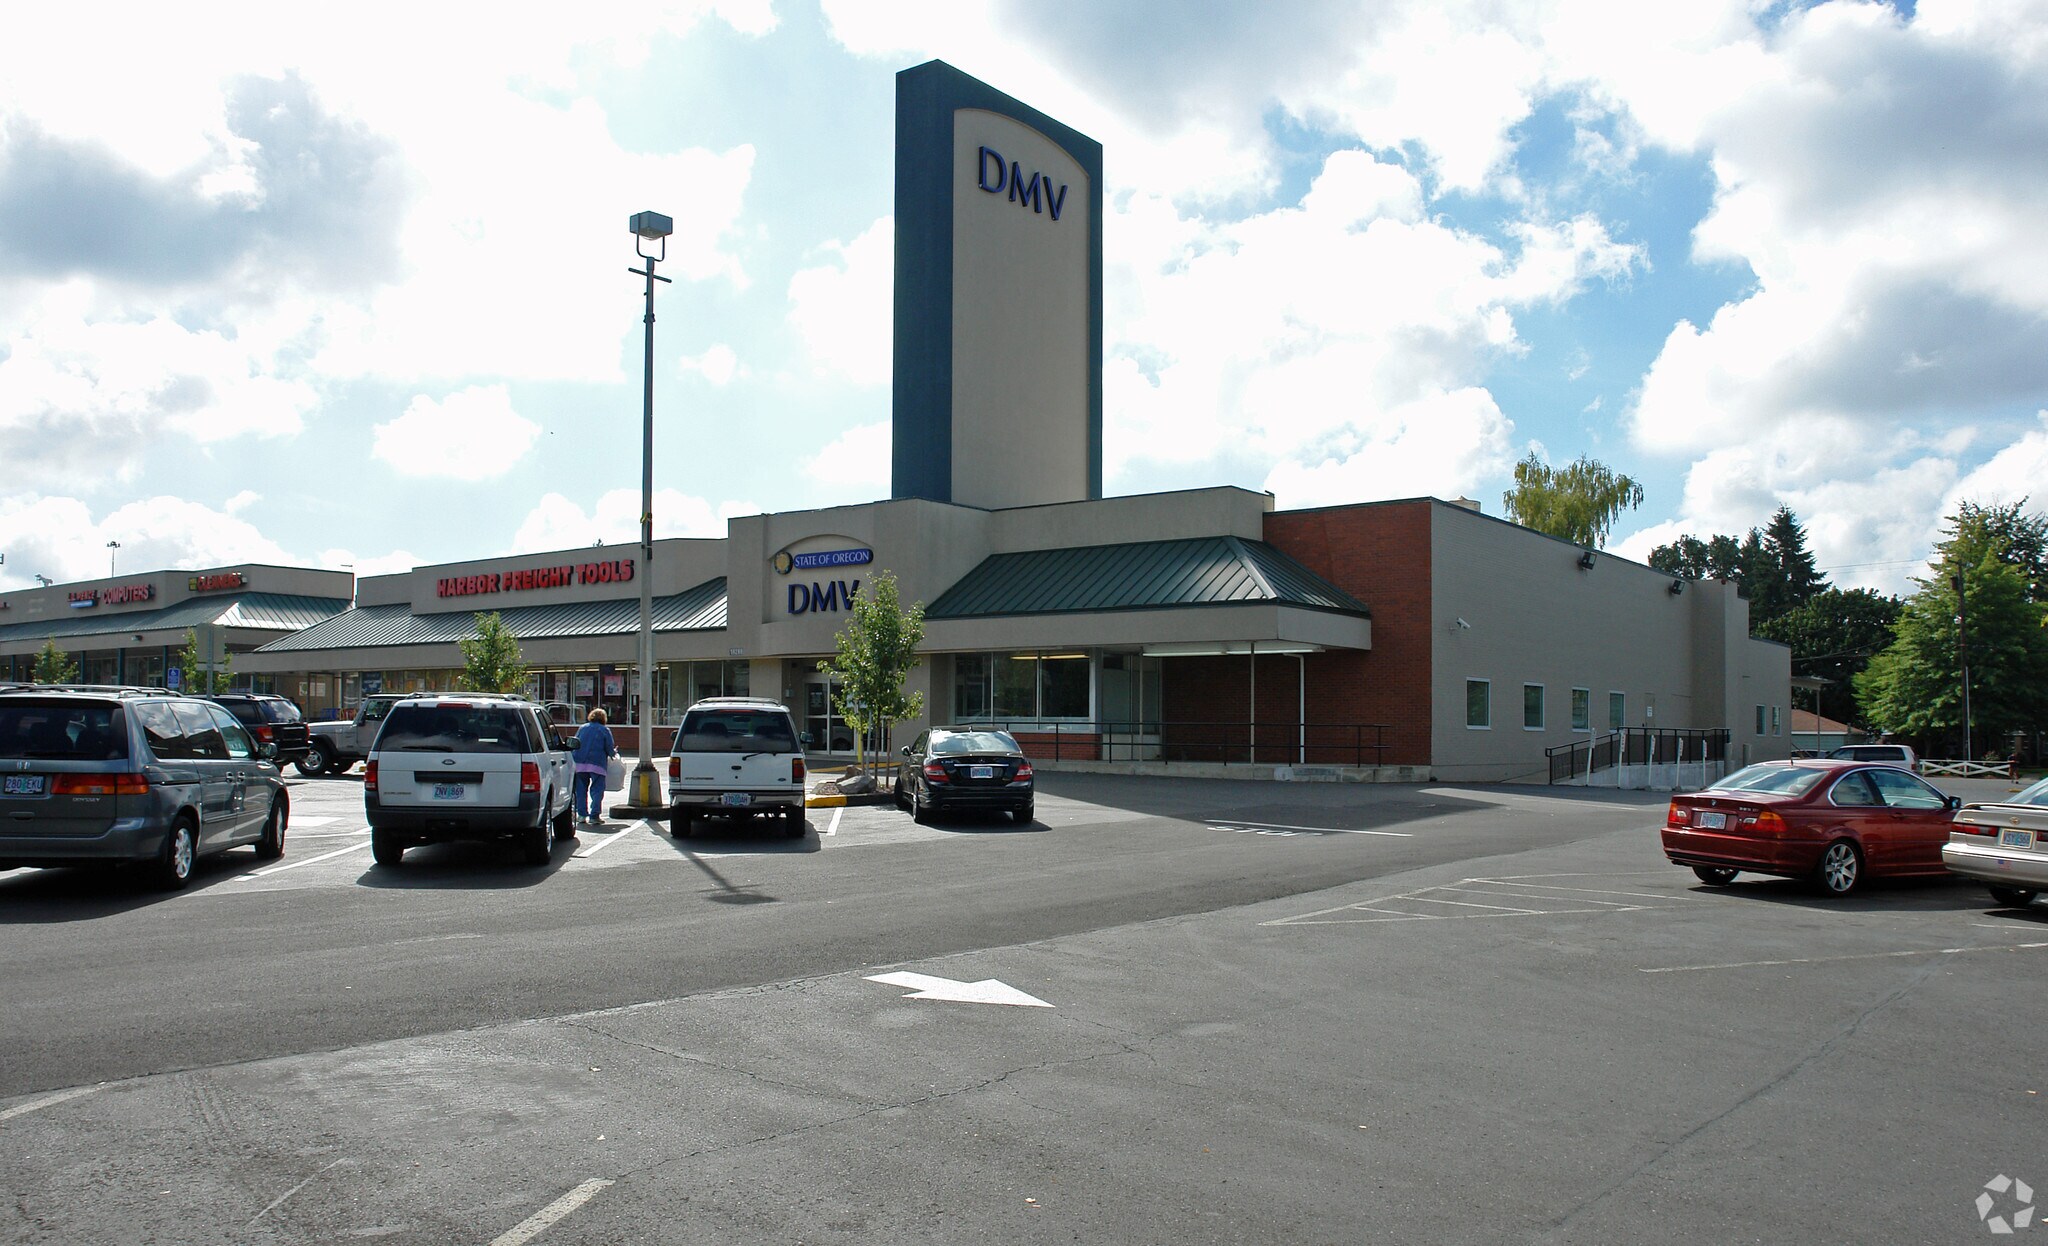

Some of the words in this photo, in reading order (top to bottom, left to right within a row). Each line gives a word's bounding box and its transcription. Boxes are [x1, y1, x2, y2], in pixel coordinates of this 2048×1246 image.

[978, 145, 1068, 221] DMV
[795, 556, 817, 567] STATE
[818, 554, 831, 565] OF
[832, 550, 870, 564] OREGON
[103, 583, 150, 605] COMPUTERS
[437, 573, 500, 597] HARBOR
[502, 565, 573, 591] FREIGHT
[576, 559, 635, 584] TOOLS
[788, 579, 861, 615] DMV
